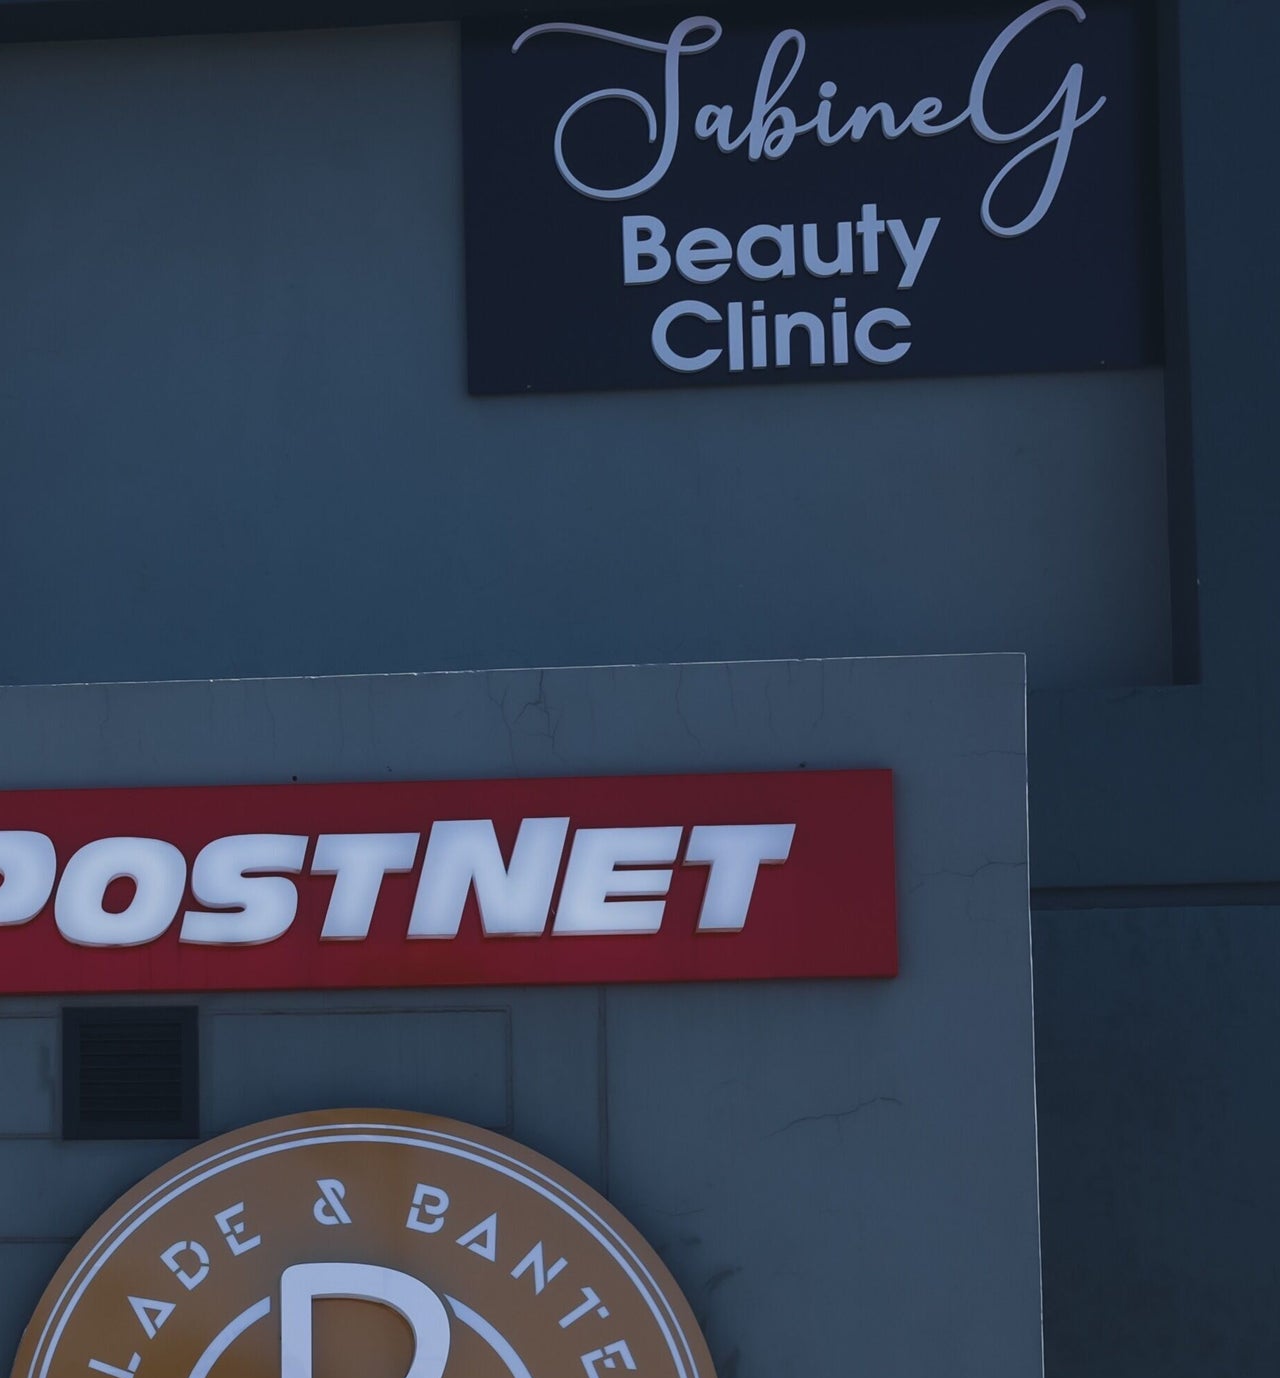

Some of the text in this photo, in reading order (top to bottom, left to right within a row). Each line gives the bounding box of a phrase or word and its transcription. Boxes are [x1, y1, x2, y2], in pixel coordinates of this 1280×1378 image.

[622, 203, 941, 290] Beauty
[651, 297, 912, 373] Clinic
[313, 1178, 353, 1226] &
